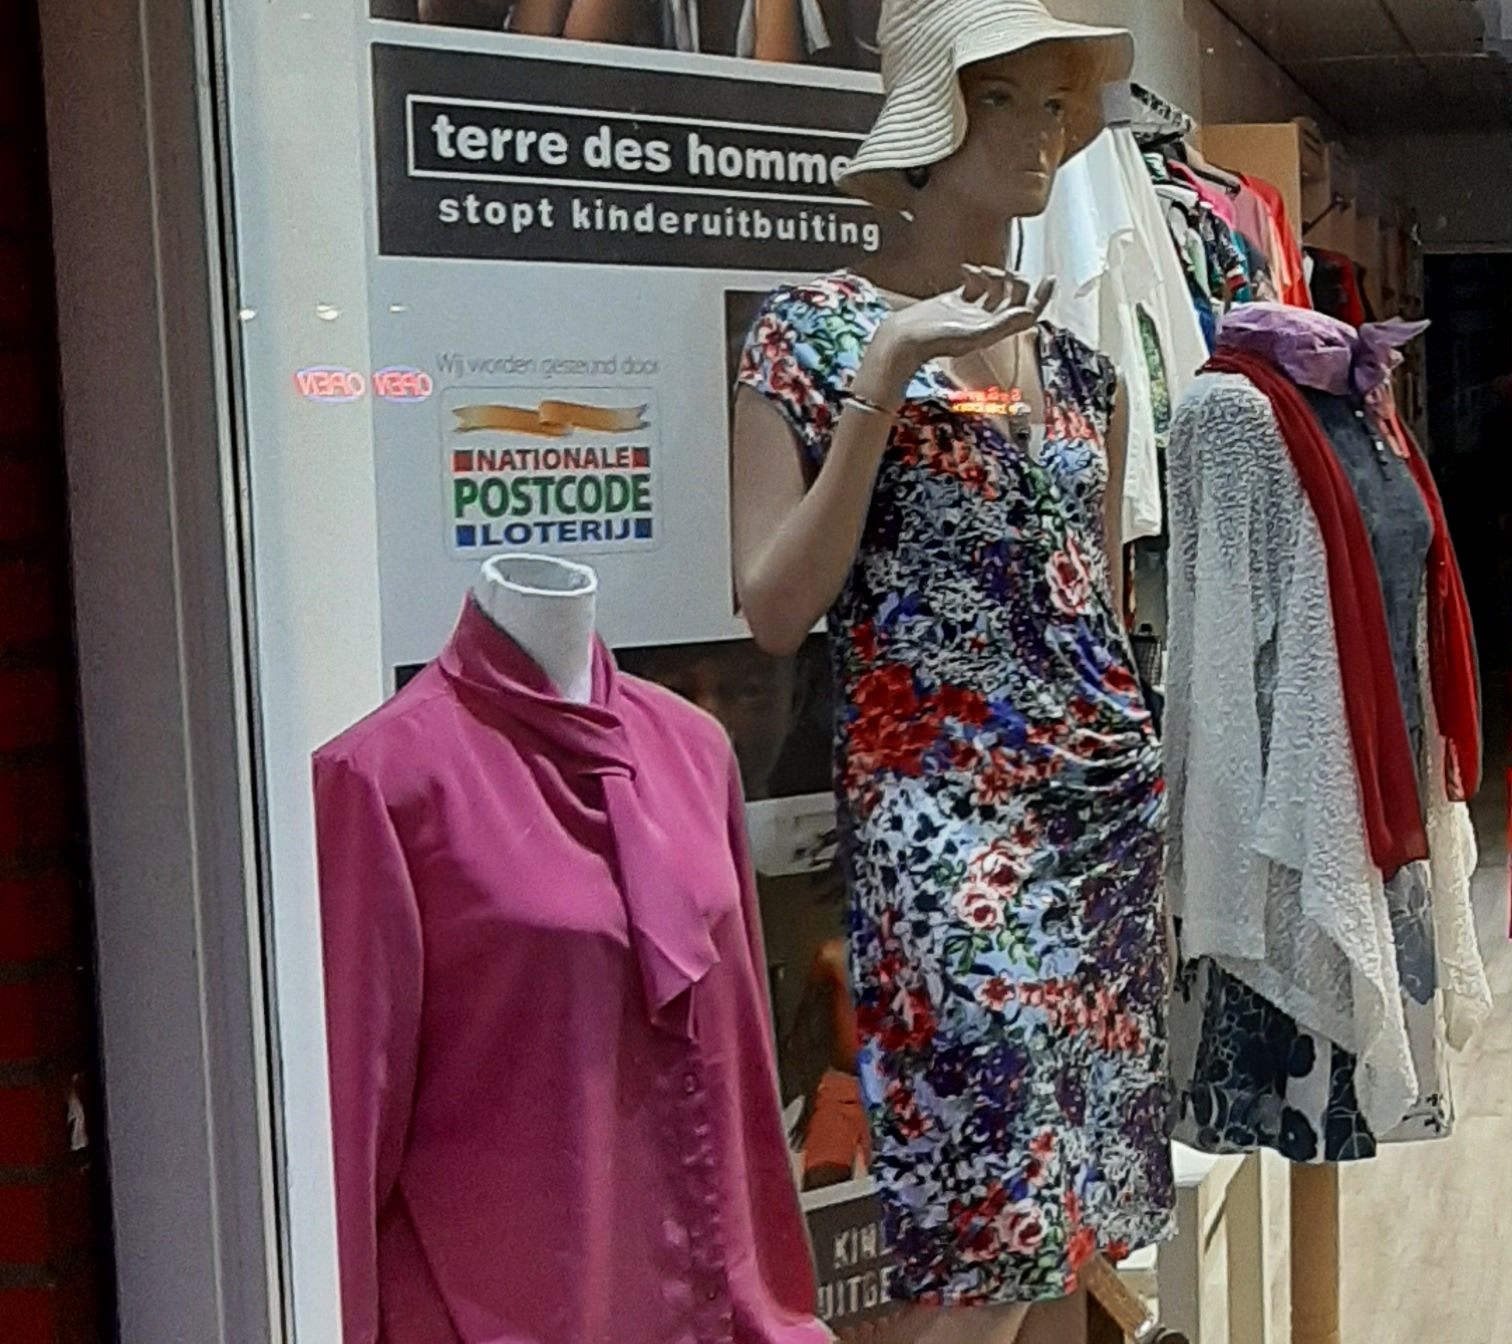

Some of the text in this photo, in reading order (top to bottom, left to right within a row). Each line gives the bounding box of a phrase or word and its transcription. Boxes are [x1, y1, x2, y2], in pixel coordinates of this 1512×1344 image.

[431, 114, 851, 185] terre des homme
[437, 193, 880, 252] stopt kinderuitbuiting
[476, 446, 631, 472] NATIONALE
[453, 473, 653, 519] POSTCODE
[480, 518, 631, 546] LOTERIJ
[833, 1222, 887, 1270] KIN
[817, 1264, 898, 1321] UITGE
